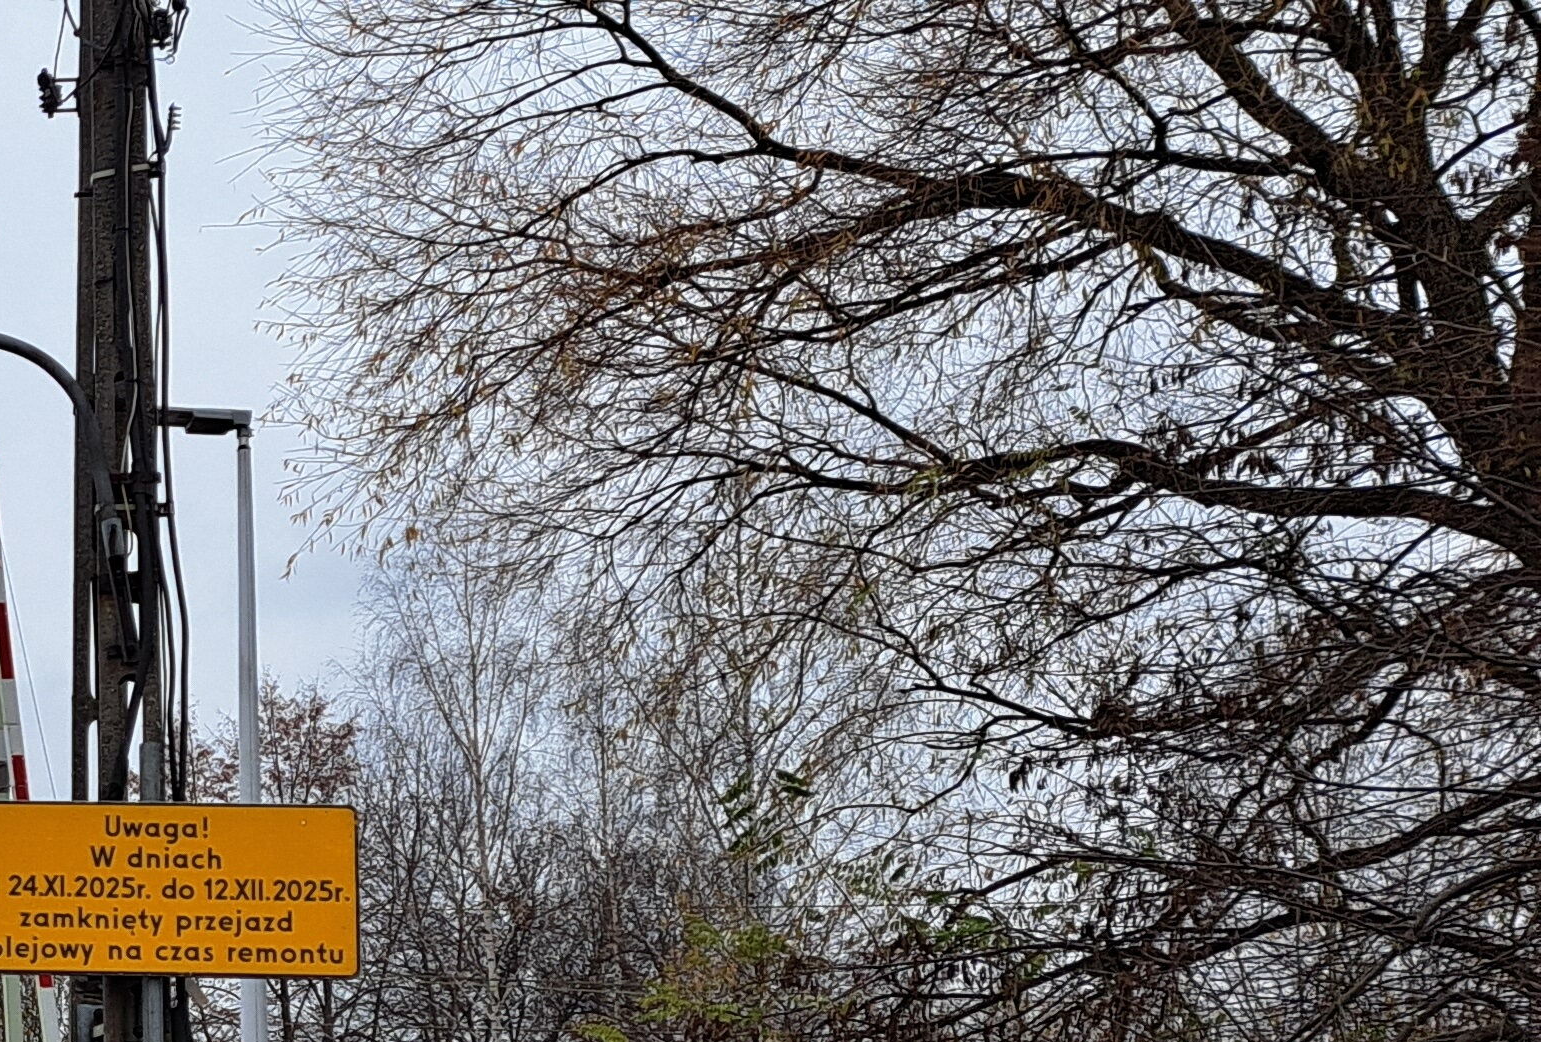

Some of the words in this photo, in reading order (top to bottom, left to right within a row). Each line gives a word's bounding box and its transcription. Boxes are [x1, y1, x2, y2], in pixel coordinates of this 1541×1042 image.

[104, 815, 209, 844] Uwaga!
[90, 846, 116, 868] W
[127, 846, 222, 870] dniach
[8, 875, 151, 900] 24.XI.2025r.
[162, 877, 194, 900] do
[204, 878, 351, 903] 12.XII.2025r.
[19, 907, 163, 937] zamknięty
[176, 909, 293, 937] przejazd
[109, 944, 142, 961] na
[155, 944, 214, 962] czas
[227, 941, 344, 965] remontu
